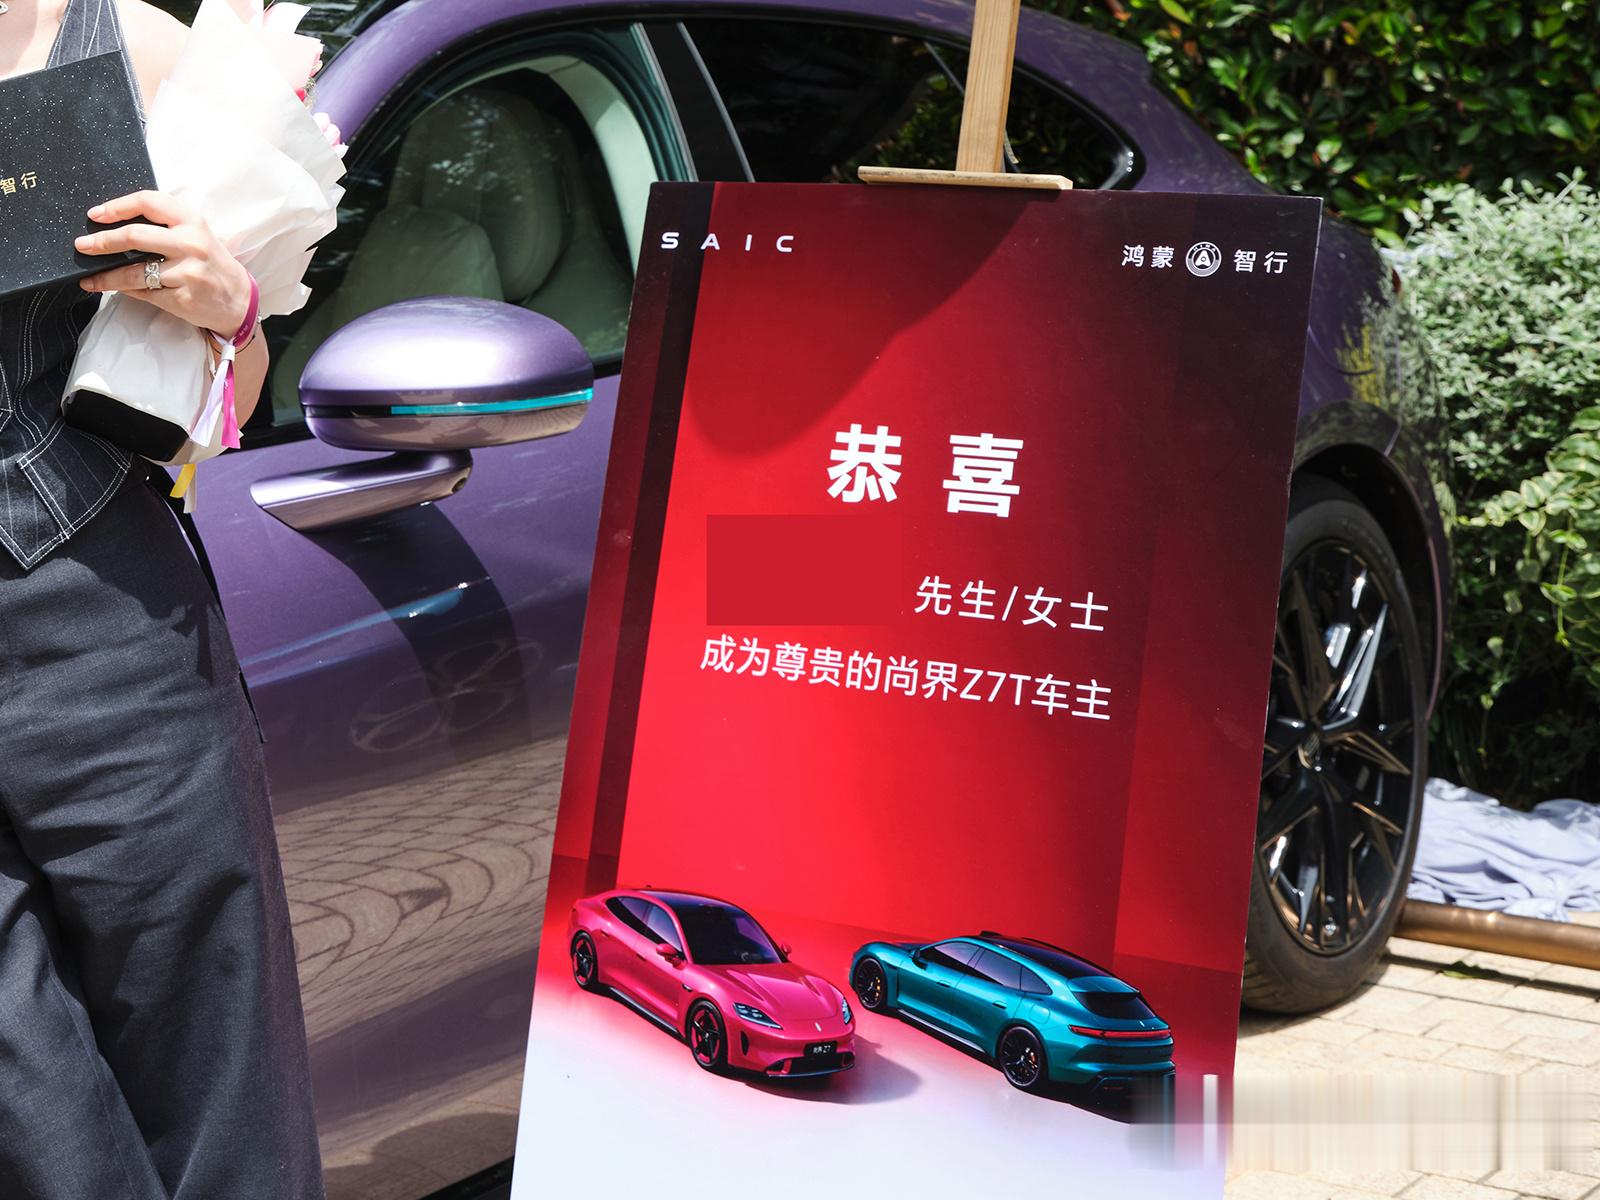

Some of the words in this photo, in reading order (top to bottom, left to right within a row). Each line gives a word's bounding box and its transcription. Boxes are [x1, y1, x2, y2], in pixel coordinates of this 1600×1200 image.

[0, 171, 38, 196] 智行
[660, 231, 795, 253] SAIC
[1121, 244, 1175, 269] 鸿蒙
[1233, 249, 1288, 274] 智行
[826, 423, 1024, 518] 恭喜
[913, 575, 1110, 632] 先生/女士
[699, 633, 1112, 721] 成为尊贵的尚界Z7T车主
